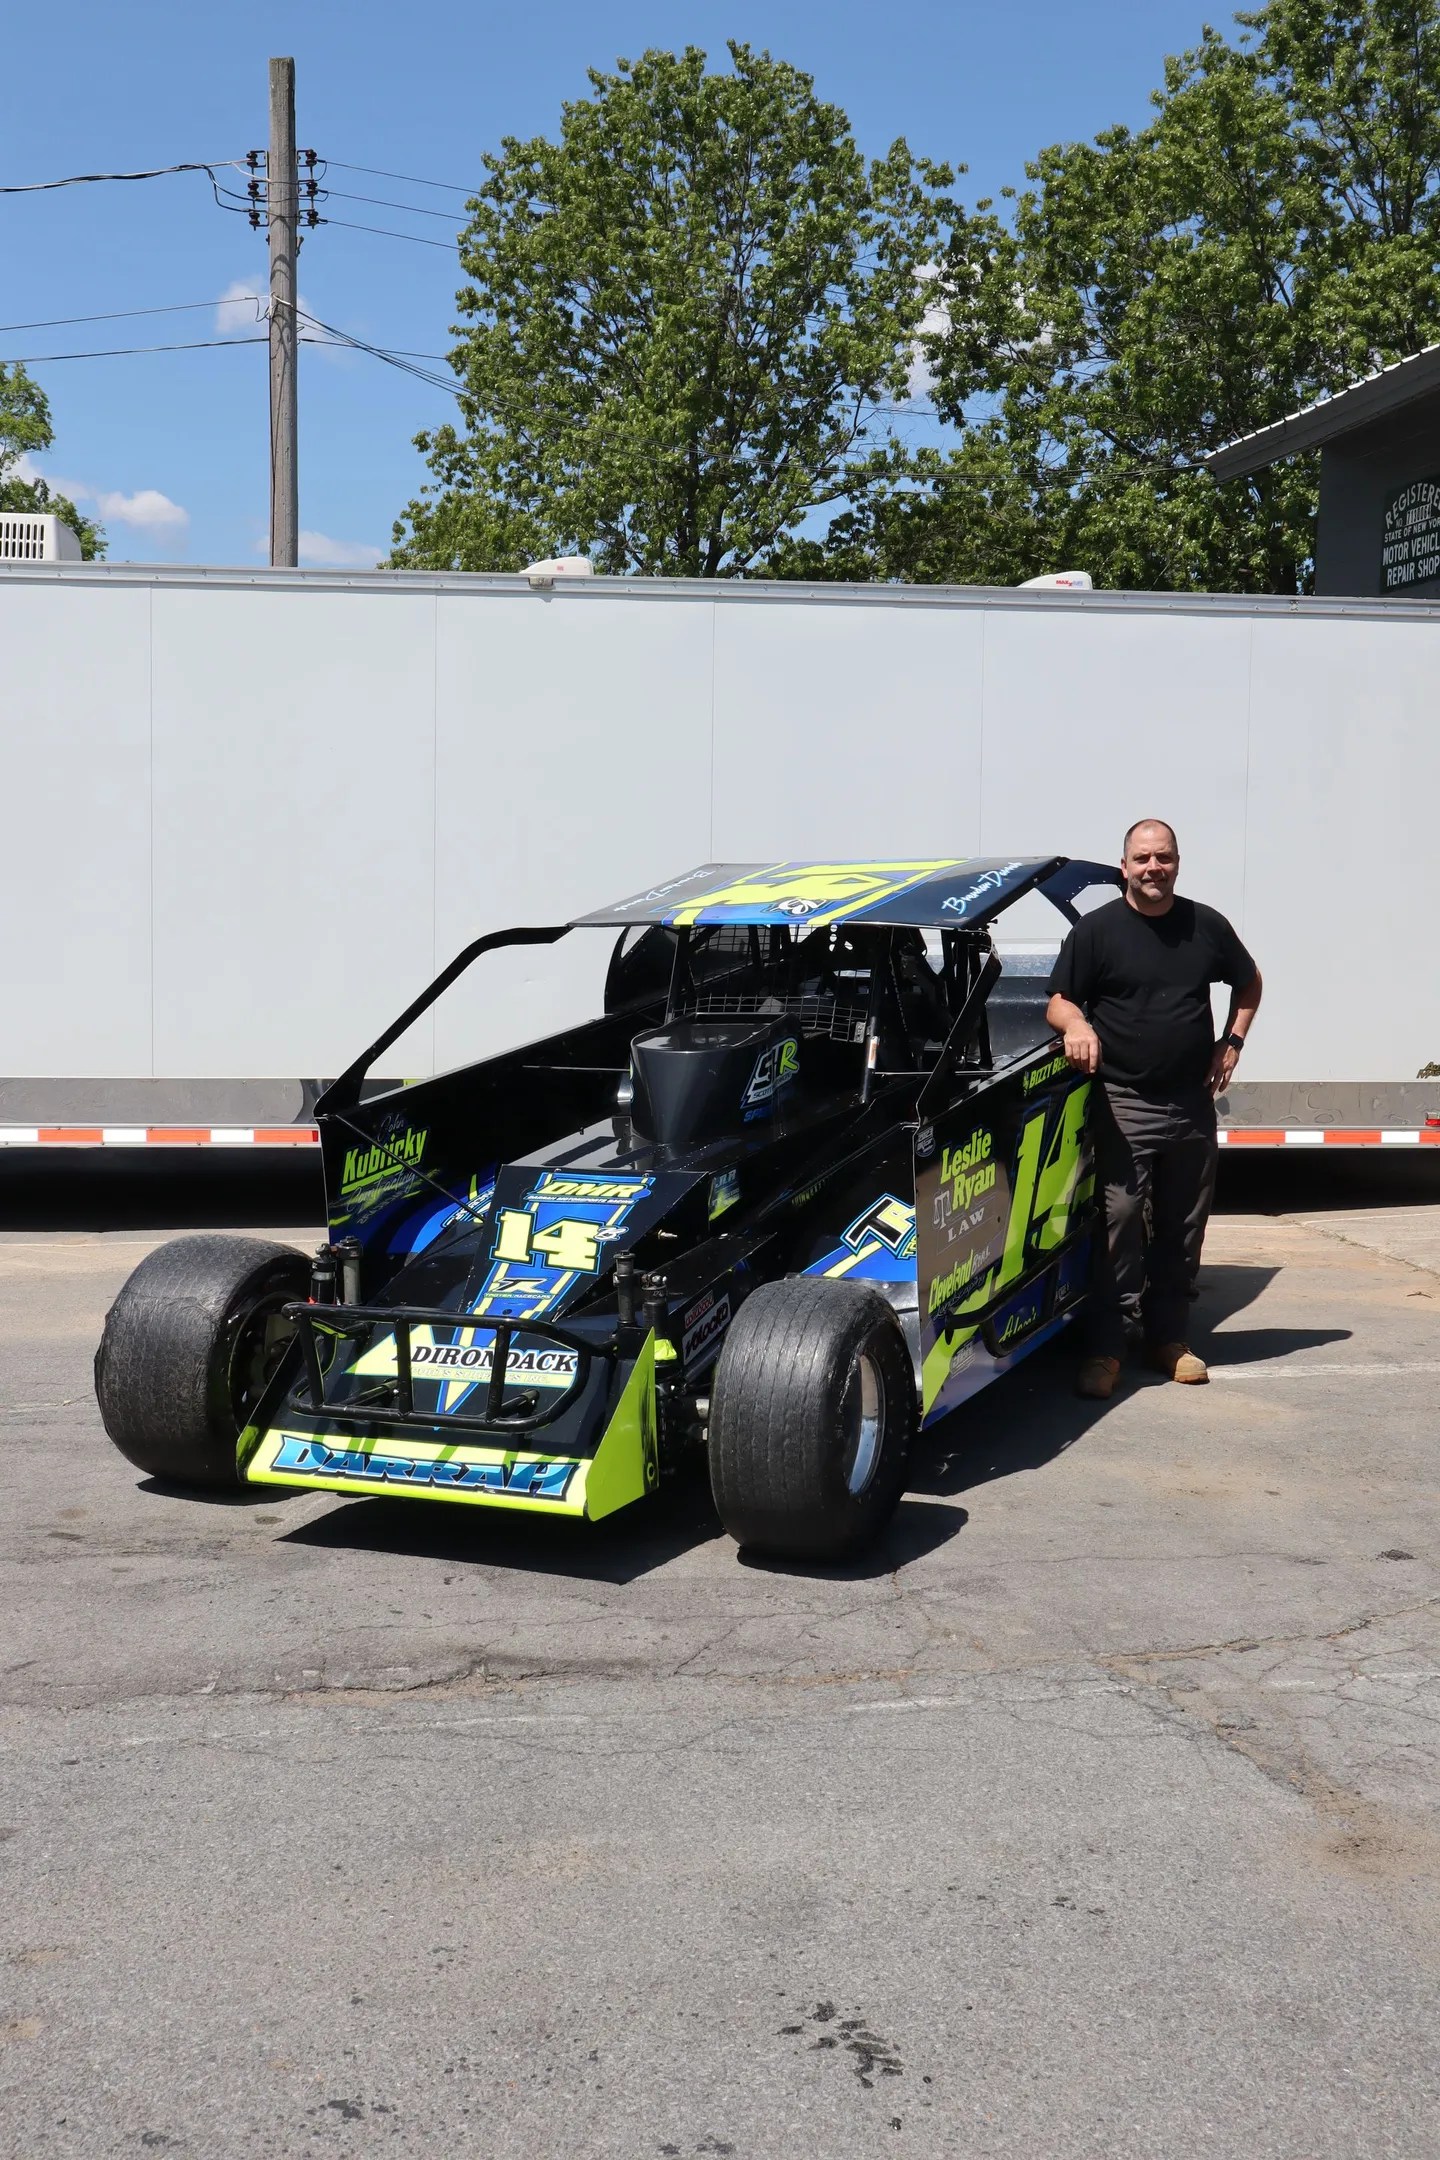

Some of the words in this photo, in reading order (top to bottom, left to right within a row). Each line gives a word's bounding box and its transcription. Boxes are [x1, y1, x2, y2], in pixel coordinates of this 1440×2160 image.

[1386, 483, 1440, 529] REGISTERE
[1383, 541, 1409, 566] MOTOR
[1411, 532, 1440, 557] VEHICL
[1385, 529, 1401, 543] STATE
[1403, 526, 1412, 537] OF
[1413, 521, 1426, 533] NEW
[1429, 517, 1440, 529] YOR
[1387, 562, 1415, 587] REPAIR
[1417, 555, 1440, 578] SHOP
[1029, 1062, 1053, 1089] BIZZY
[342, 1128, 428, 1184] Kubricky
[940, 1128, 992, 1184] Leslie
[537, 1182, 645, 1198] DMR
[952, 1162, 996, 1211] Ryan
[995, 1081, 1096, 1290] 14
[494, 1210, 600, 1271] 14
[947, 1207, 985, 1242] LAW
[928, 1249, 974, 1315] Cleveland
[392, 1345, 578, 1373] DIRONDACK
[271, 1435, 578, 1498] DARRAH
